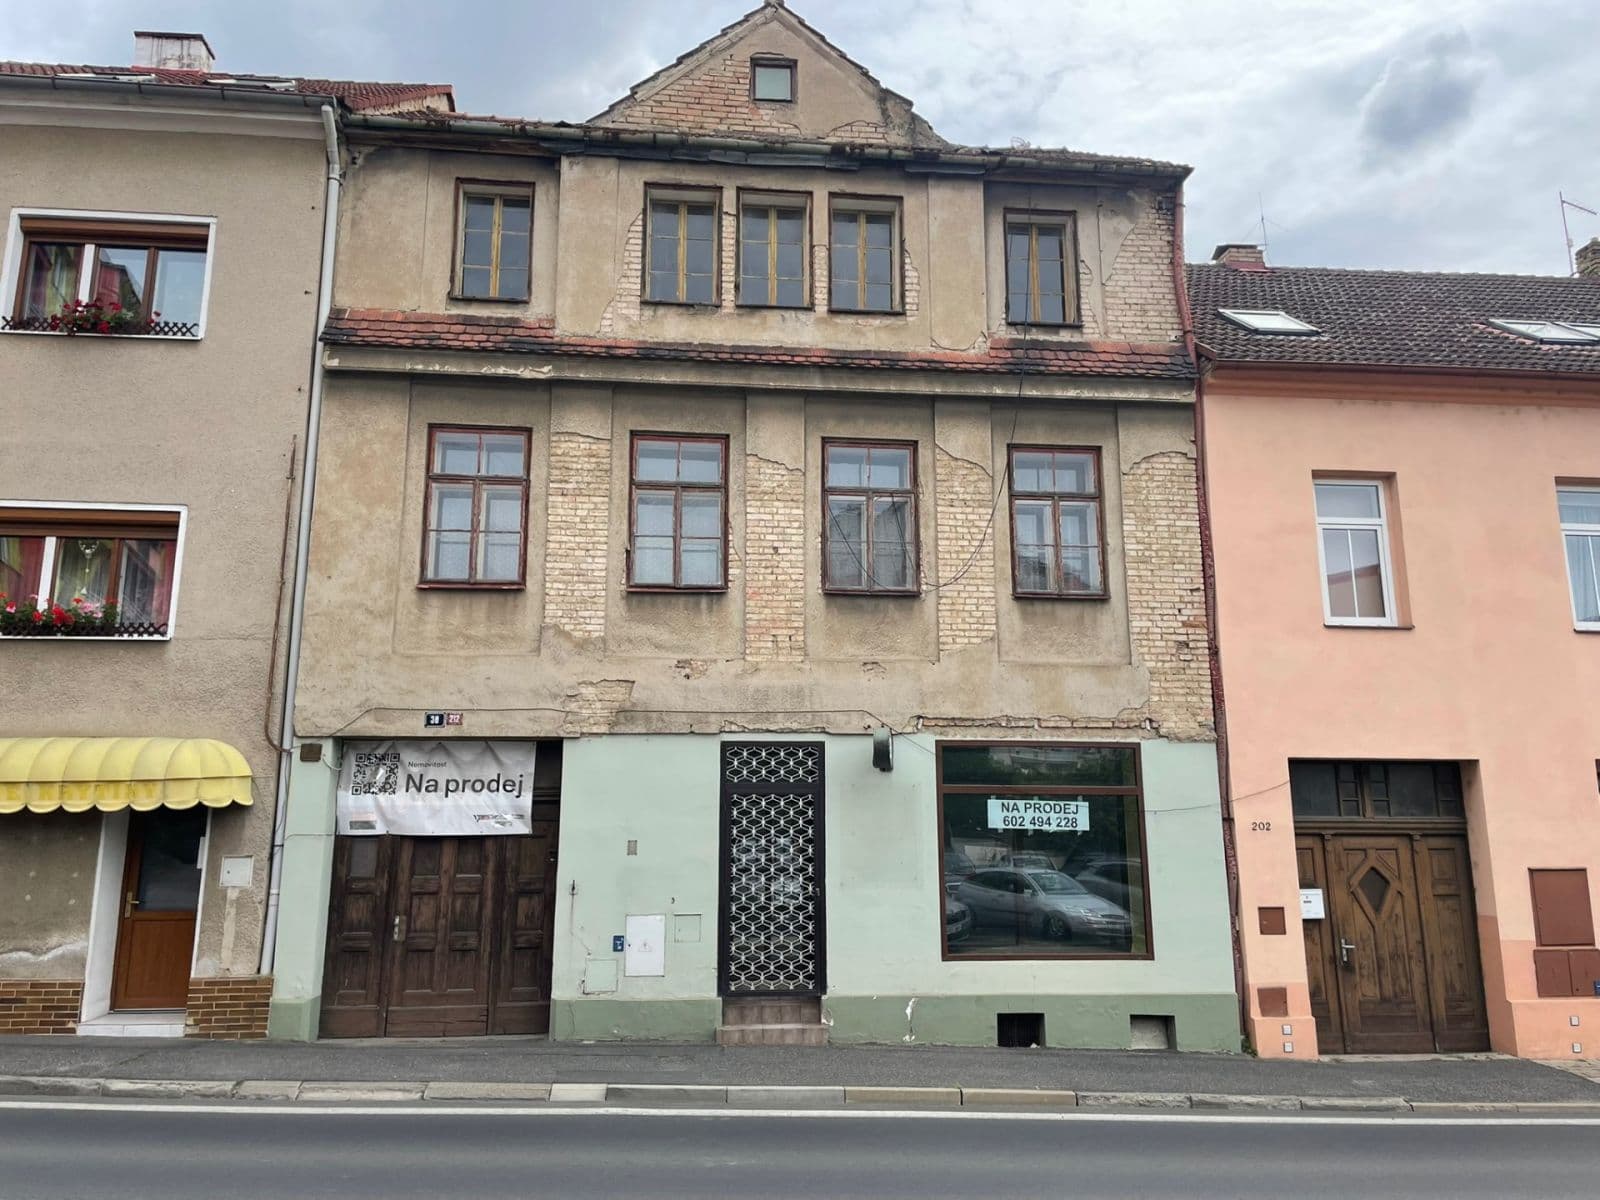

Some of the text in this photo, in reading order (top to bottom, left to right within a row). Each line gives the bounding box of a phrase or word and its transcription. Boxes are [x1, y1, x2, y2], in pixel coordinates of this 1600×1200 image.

[405, 773, 524, 798] Na prodej
[1001, 802, 1079, 814] NA PRODEJ
[1003, 815, 1078, 828] 602 494 228
[1251, 821, 1272, 831] 202
